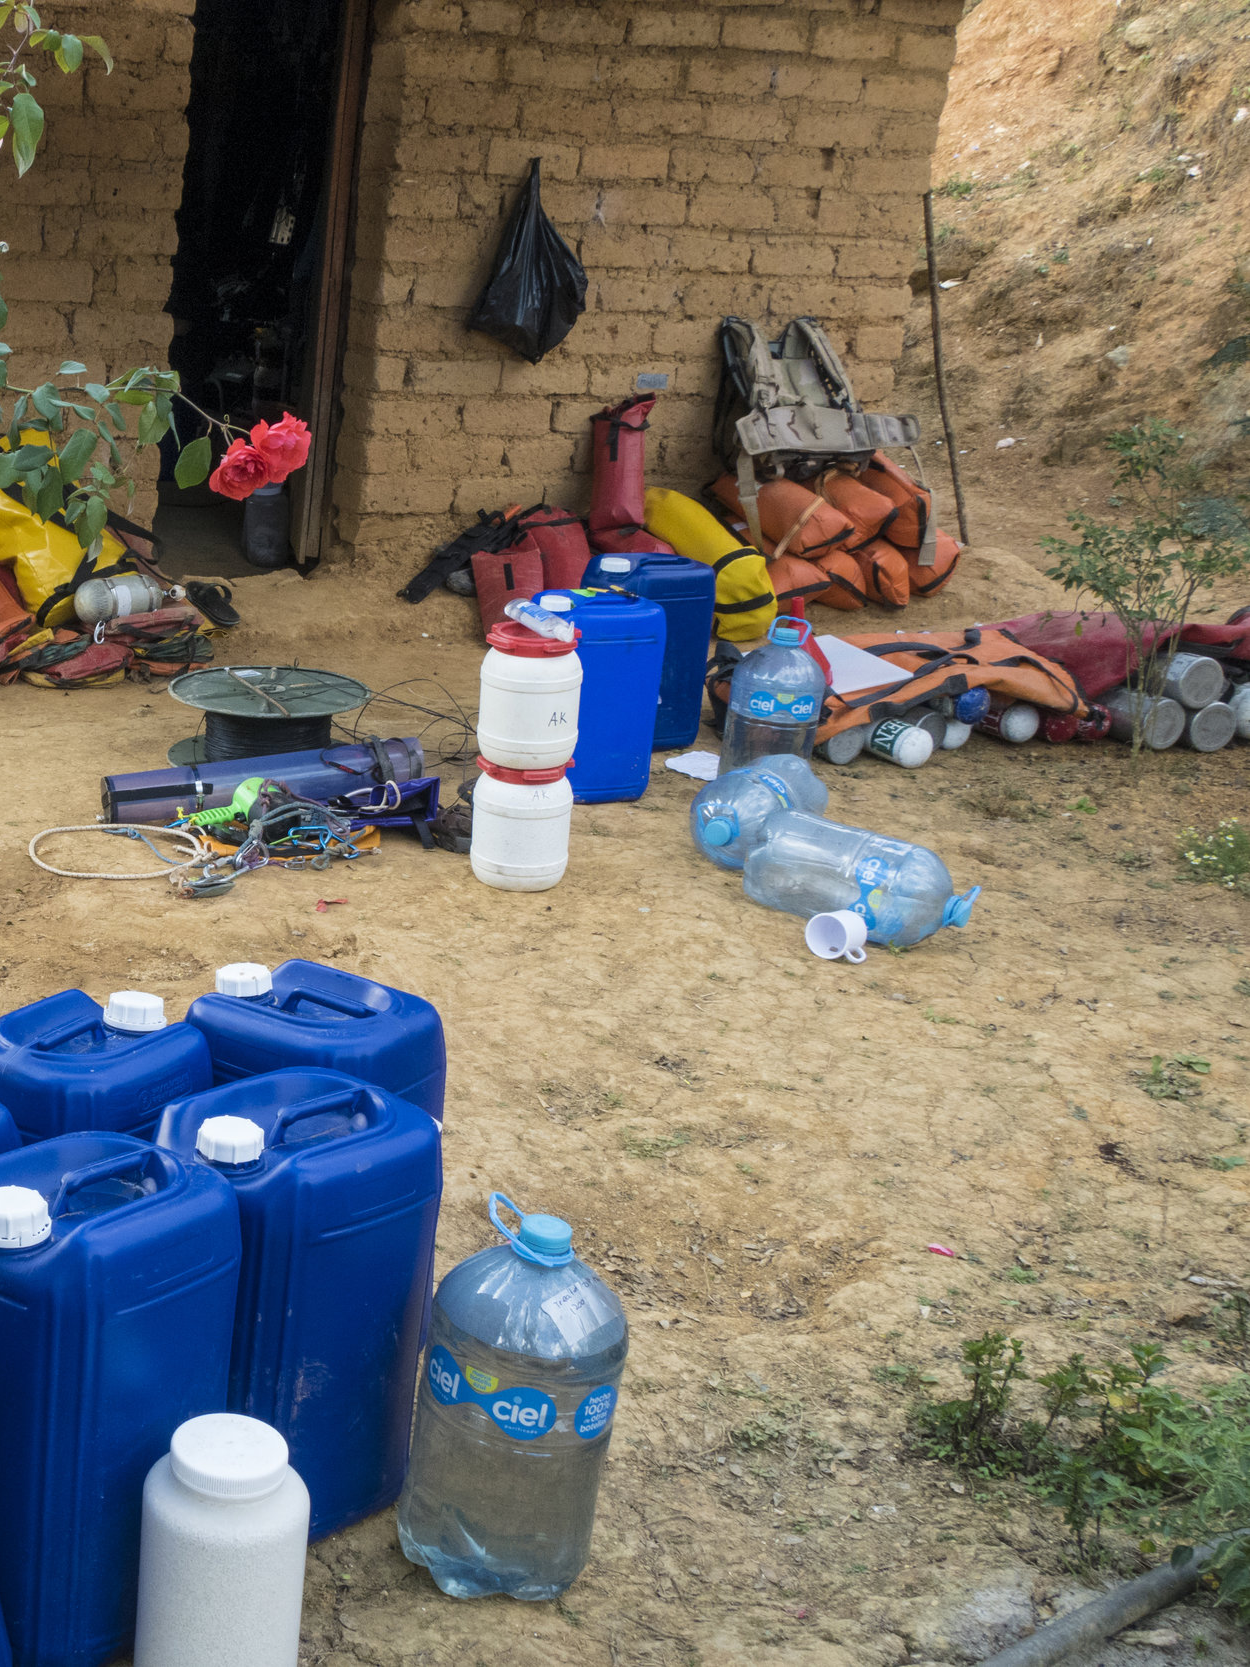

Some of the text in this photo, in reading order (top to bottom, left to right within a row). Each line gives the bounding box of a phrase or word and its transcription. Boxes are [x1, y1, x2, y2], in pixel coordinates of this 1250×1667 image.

[750, 695, 775, 712] ciel
[791, 700, 814, 715] ciel
[548, 711, 567, 727] AK
[762, 774, 785, 794] ciel
[532, 790, 550, 801] AK
[860, 859, 882, 886] ciel
[430, 1358, 460, 1400] ciel
[589, 1392, 611, 1404] hecho
[492, 1396, 549, 1428] ciel
[584, 1400, 611, 1416] 100%
